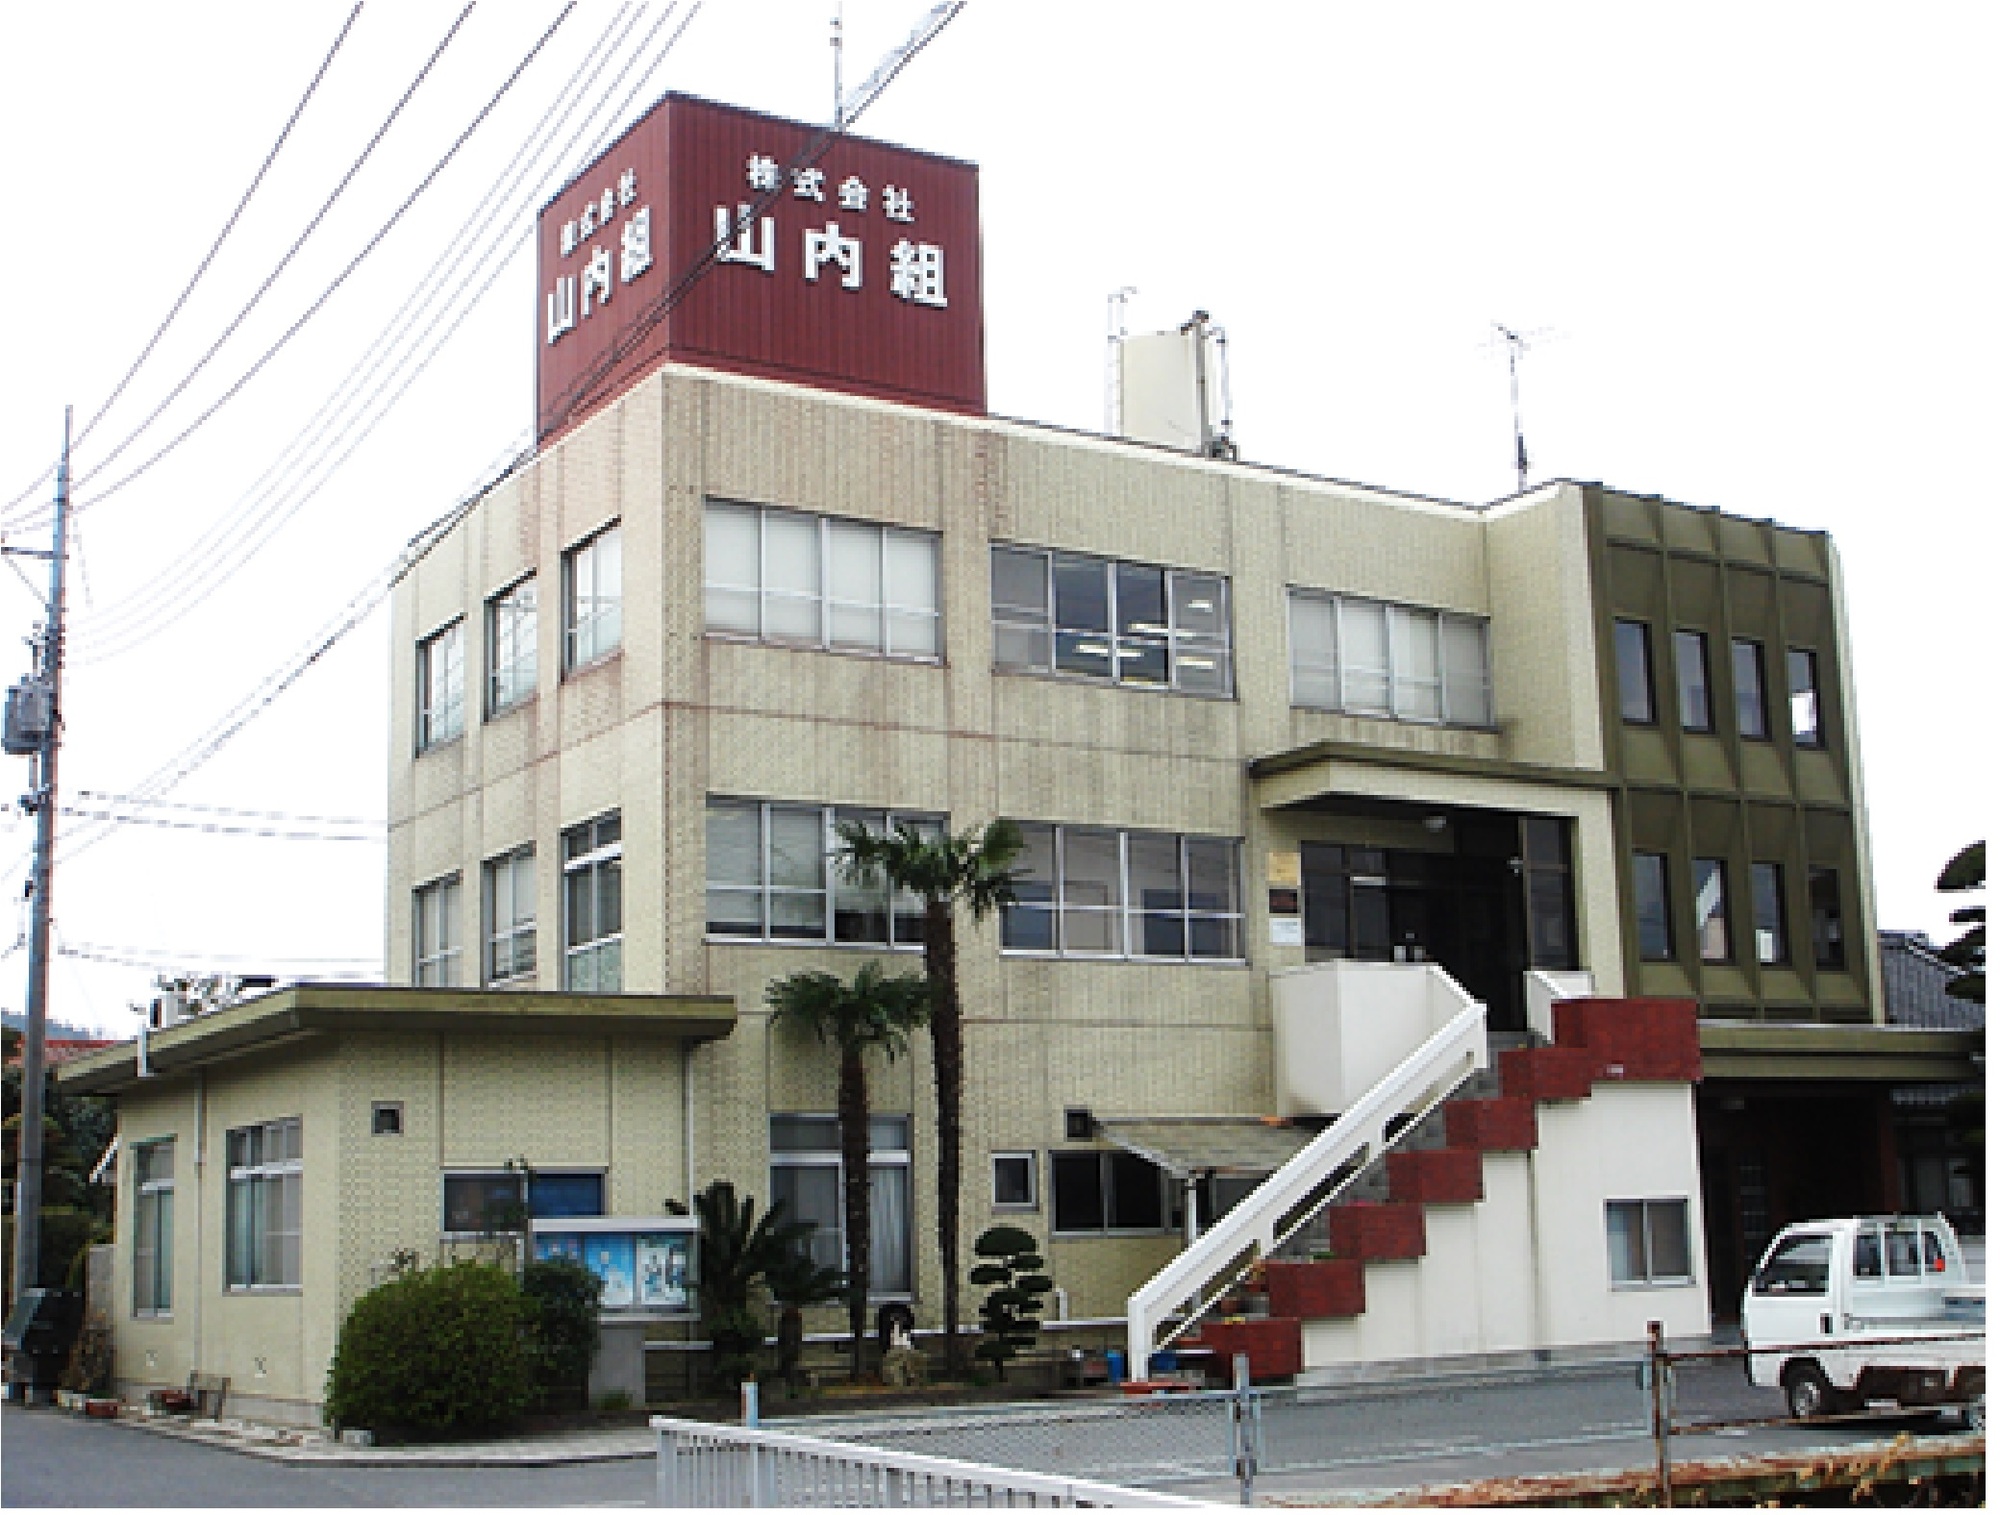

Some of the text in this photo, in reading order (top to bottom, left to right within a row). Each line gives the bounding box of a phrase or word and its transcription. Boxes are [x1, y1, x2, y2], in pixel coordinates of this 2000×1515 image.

[746, 153, 914, 222] 株式会社
[547, 206, 653, 343] 山内組
[714, 203, 946, 306] 山内組
